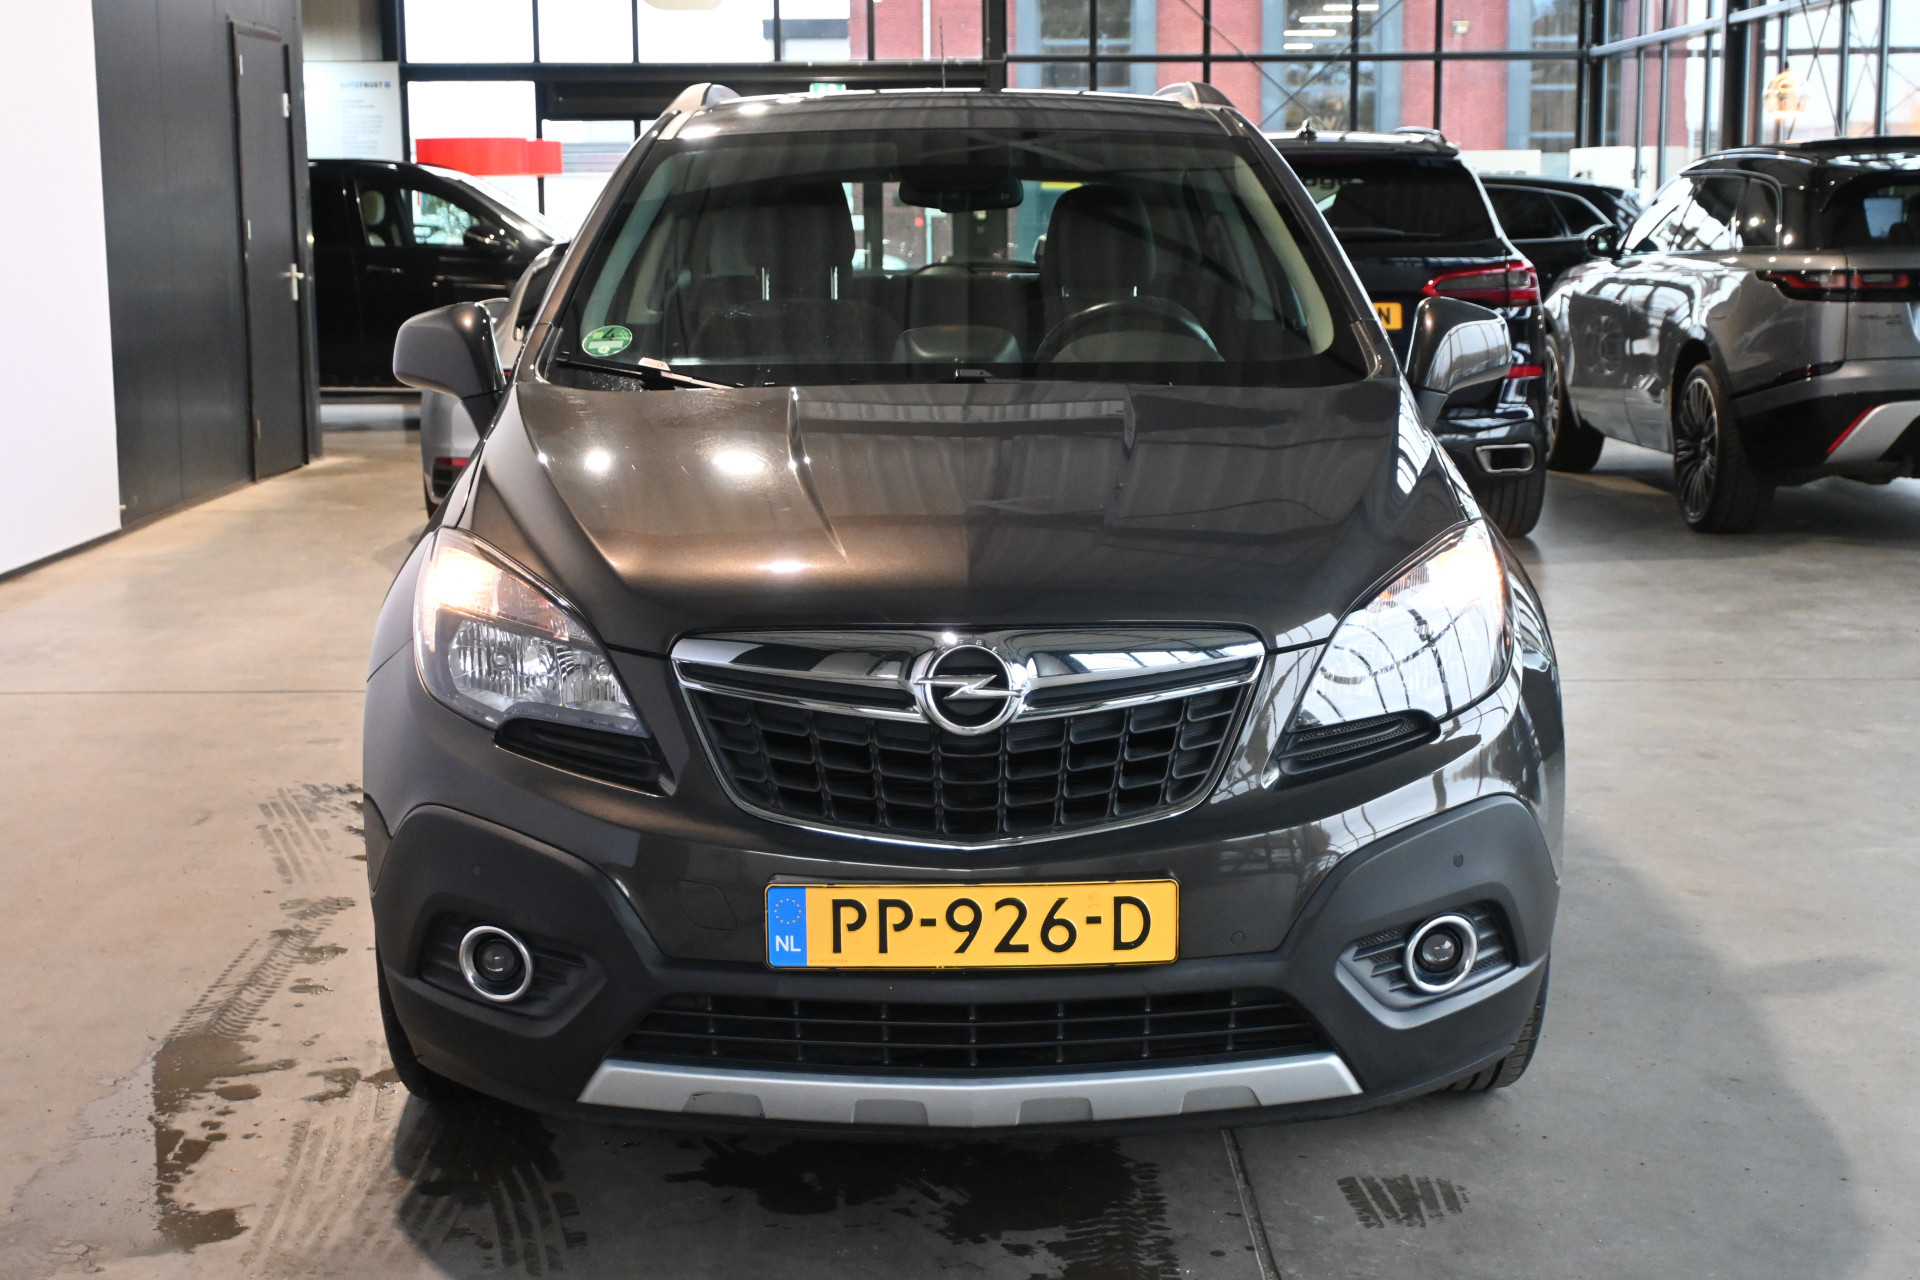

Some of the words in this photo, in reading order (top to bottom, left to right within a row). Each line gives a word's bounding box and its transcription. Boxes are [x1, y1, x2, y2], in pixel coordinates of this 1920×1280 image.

[602, 327, 616, 341] 4
[832, 896, 1151, 954] PP-926-D
[775, 935, 802, 952] NL
